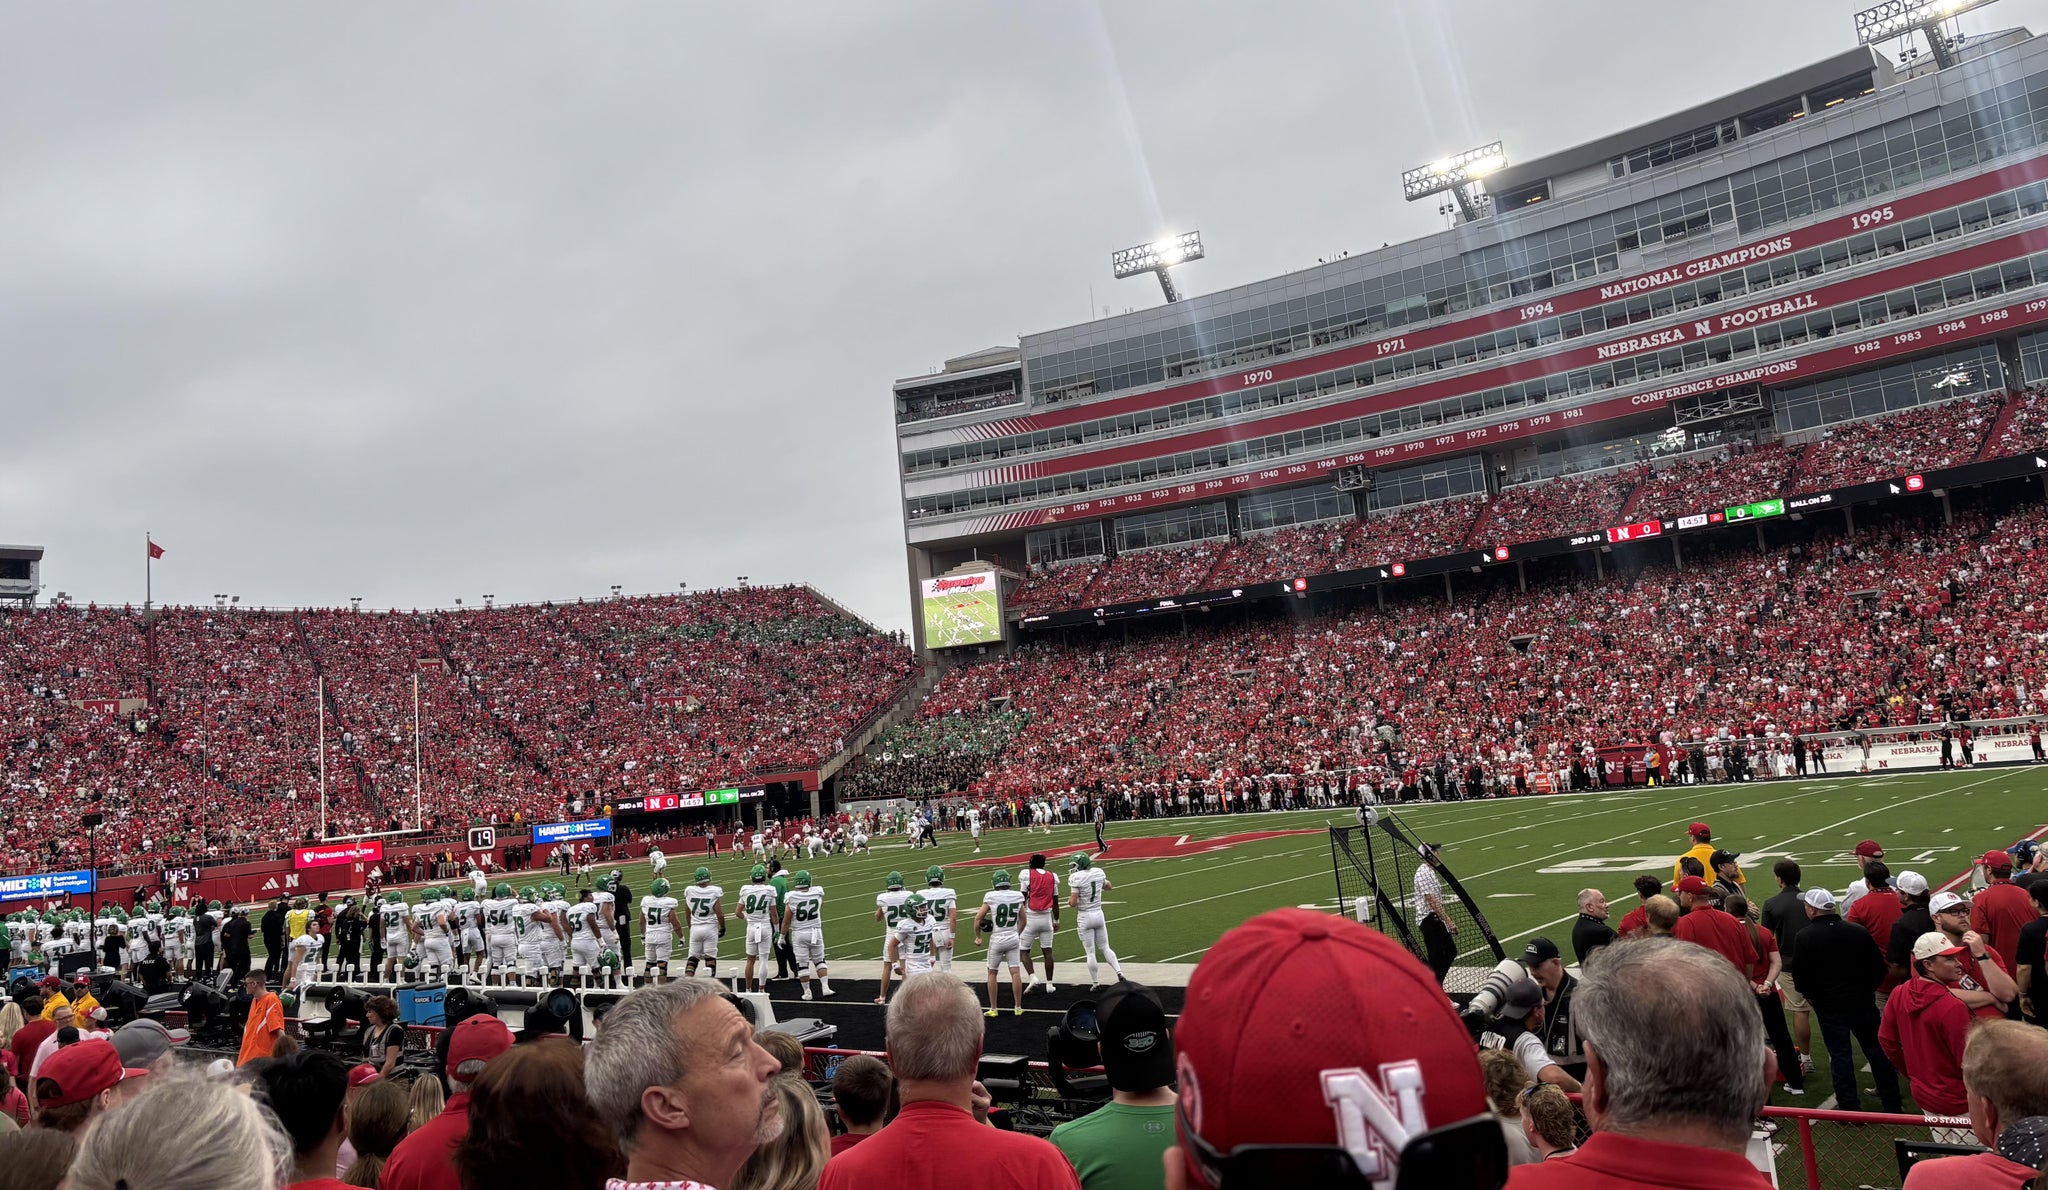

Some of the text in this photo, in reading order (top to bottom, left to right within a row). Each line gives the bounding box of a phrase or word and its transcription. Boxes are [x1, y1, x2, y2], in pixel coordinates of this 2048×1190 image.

[1852, 206, 1894, 230] 1995
[1600, 236, 1792, 300] NATIONAL CHAMPIONS
[1520, 302, 1554, 320] 1994
[2025, 299, 2048, 313] 199
[1980, 309, 2009, 325] 1988
[1597, 294, 1818, 359] NEBRASKA N FOOTBALL
[1937, 320, 1966, 335] 1984
[1894, 331, 1922, 345] 1983
[1376, 339, 1406, 355] 1971
[1854, 340, 1881, 354] 1982
[1243, 369, 1273, 386] 1970
[1631, 360, 1798, 405] CONFERENCE CHAMPIONS
[1562, 408, 1583, 420] 1981
[1529, 415, 1551, 427] 1978
[1498, 422, 1519, 433] 1975
[1466, 429, 1487, 440] 1972
[1435, 435, 1455, 446] 1971
[1404, 441, 1425, 452] 1970
[1375, 447, 1395, 458] 1969
[1317, 458, 1337, 469] 1964
[1345, 453, 1365, 464] 1966
[1260, 469, 1279, 480] 1940
[1287, 465, 1306, 474] 1963
[1205, 479, 1223, 489] 1936
[1231, 475, 1250, 485] 1937
[1908, 477, 1921, 488] S
[1151, 489, 1169, 499] 1933
[1177, 485, 1196, 495] 1935
[1099, 499, 1116, 508] 1931
[1125, 494, 1142, 503] 1932
[1790, 500, 1808, 508] BALL
[1048, 506, 1065, 516] 1928
[1072, 503, 1090, 512] 1929
[1736, 508, 1745, 518] 0
[1682, 516, 1704, 526] 14:57
[1617, 527, 1630, 540] N
[1643, 525, 1651, 533] 0
[104, 703, 114, 713] N
[1994, 739, 2032, 748] NEBRAS
[1890, 745, 1940, 756] NEBRASKA
[1978, 753, 1988, 761] N
[650, 798, 674, 808] N 0
[709, 793, 717, 802] 0
[478, 831, 491, 845] 19
[315, 850, 345, 860] Nebraska
[345, 848, 374, 857] Meicine
[481, 853, 492, 866] N
[355, 863, 364, 872] N
[165, 867, 199, 881] 14:57
[53, 879, 88, 887] Technologies
[286, 873, 299, 888] N
[175, 886, 188, 901] N
[1089, 881, 1097, 902] 1
[690, 898, 711, 917] 75
[796, 899, 819, 921] 62
[459, 910, 467, 925] 3
[648, 907, 662, 925] 51
[995, 903, 1020, 928] 85
[1319, 1059, 1428, 1190] N
[1940, 1116, 1972, 1125] STANDI
